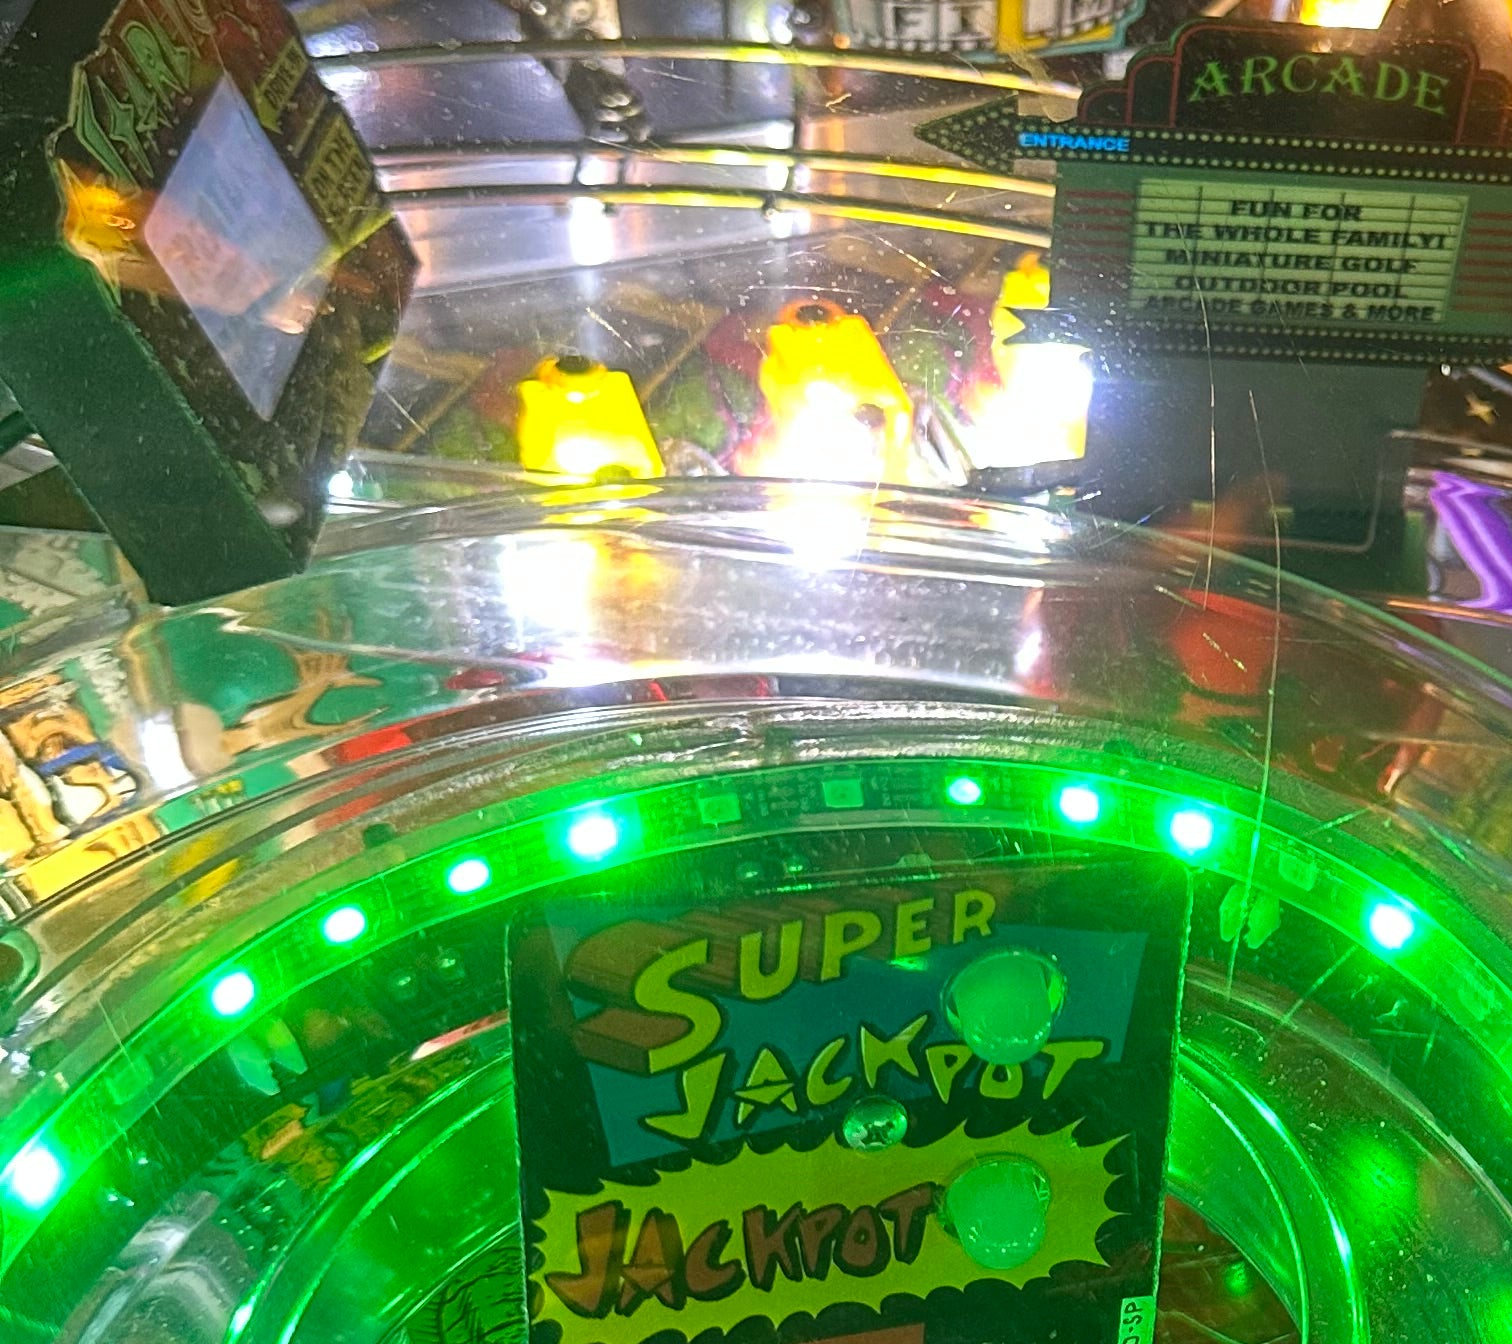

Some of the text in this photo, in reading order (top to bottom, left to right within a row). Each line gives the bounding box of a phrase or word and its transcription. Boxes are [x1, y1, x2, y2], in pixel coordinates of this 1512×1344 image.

[1189, 55, 1448, 116] ARCADE
[1018, 133, 1129, 152] ENTRANCE
[1230, 200, 1362, 222] FUN FOR
[1146, 222, 1202, 239] THE
[1215, 224, 1321, 244] WHOLE
[1166, 249, 1417, 274] MINIATURE GOLF
[1175, 276, 1408, 299] OUTDOOR POOL
[1255, 300, 1332, 318] GAMES
[1341, 303, 1360, 318] &
[1367, 306, 1434, 322] MORE
[633, 888, 997, 1073] SUPER
[645, 1014, 1103, 1141] JACKPOT
[544, 1183, 938, 1320] JACKPOT
